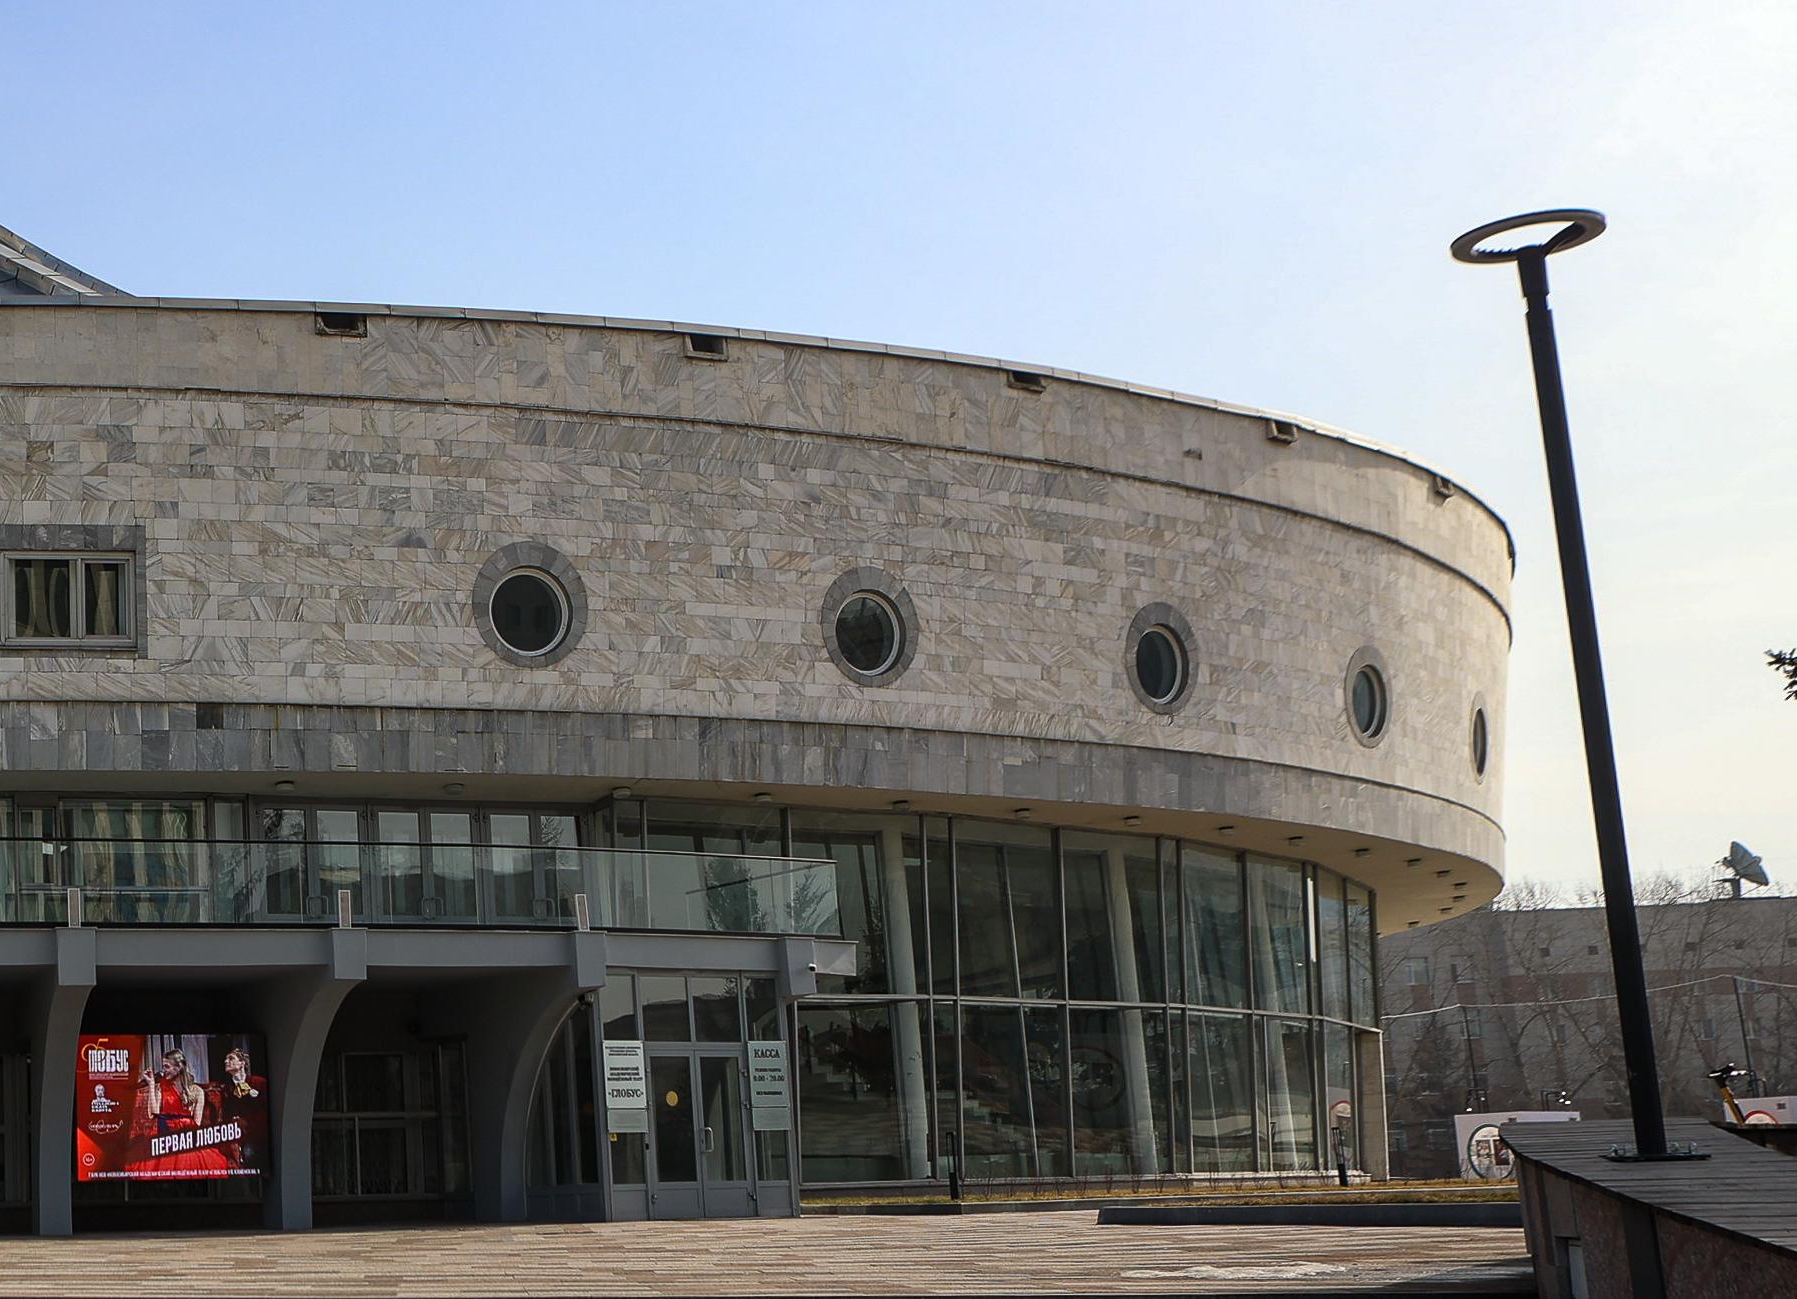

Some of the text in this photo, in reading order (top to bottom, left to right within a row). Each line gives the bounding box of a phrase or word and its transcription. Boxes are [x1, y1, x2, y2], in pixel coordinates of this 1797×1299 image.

[753, 1048, 781, 1058] КАССА
[151, 1122, 242, 1156] ПЕРВАЯ ЛЮБОВЬ
